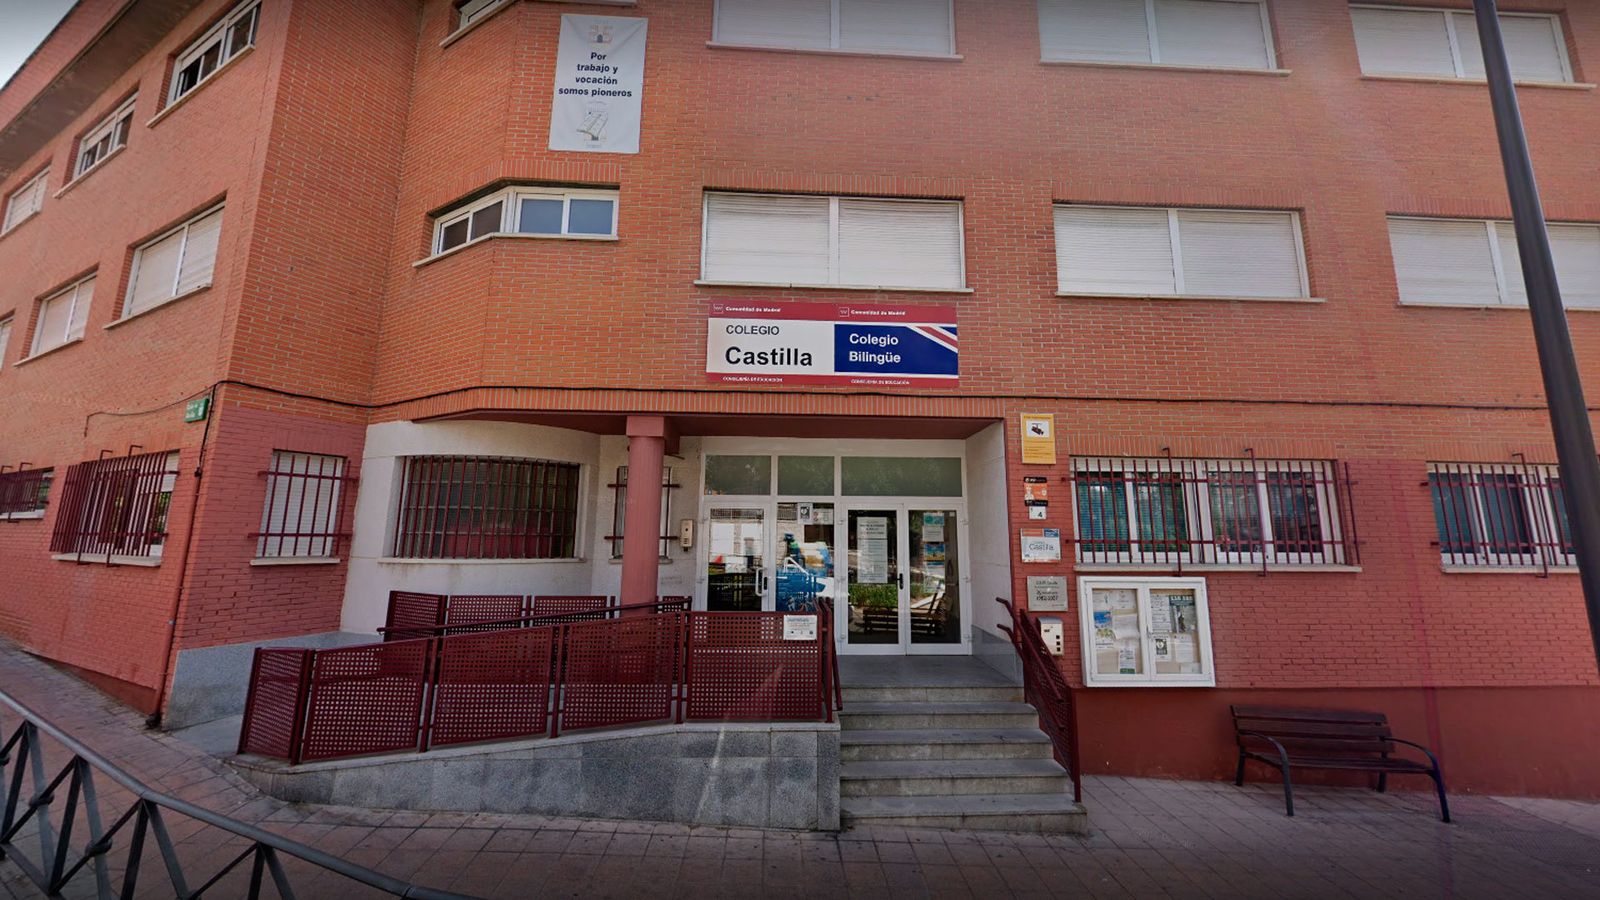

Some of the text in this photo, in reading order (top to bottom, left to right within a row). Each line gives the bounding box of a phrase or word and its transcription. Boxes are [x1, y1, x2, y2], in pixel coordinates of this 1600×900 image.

[590, 51, 607, 60] Por
[577, 63, 618, 74] trabajo y
[575, 76, 618, 85] vocación
[558, 87, 632, 97] somos pioneros
[726, 324, 780, 336] COLEGIO
[849, 333, 899, 346] Colegio
[725, 346, 812, 366] Castilla
[849, 351, 901, 365] Bilingüe
